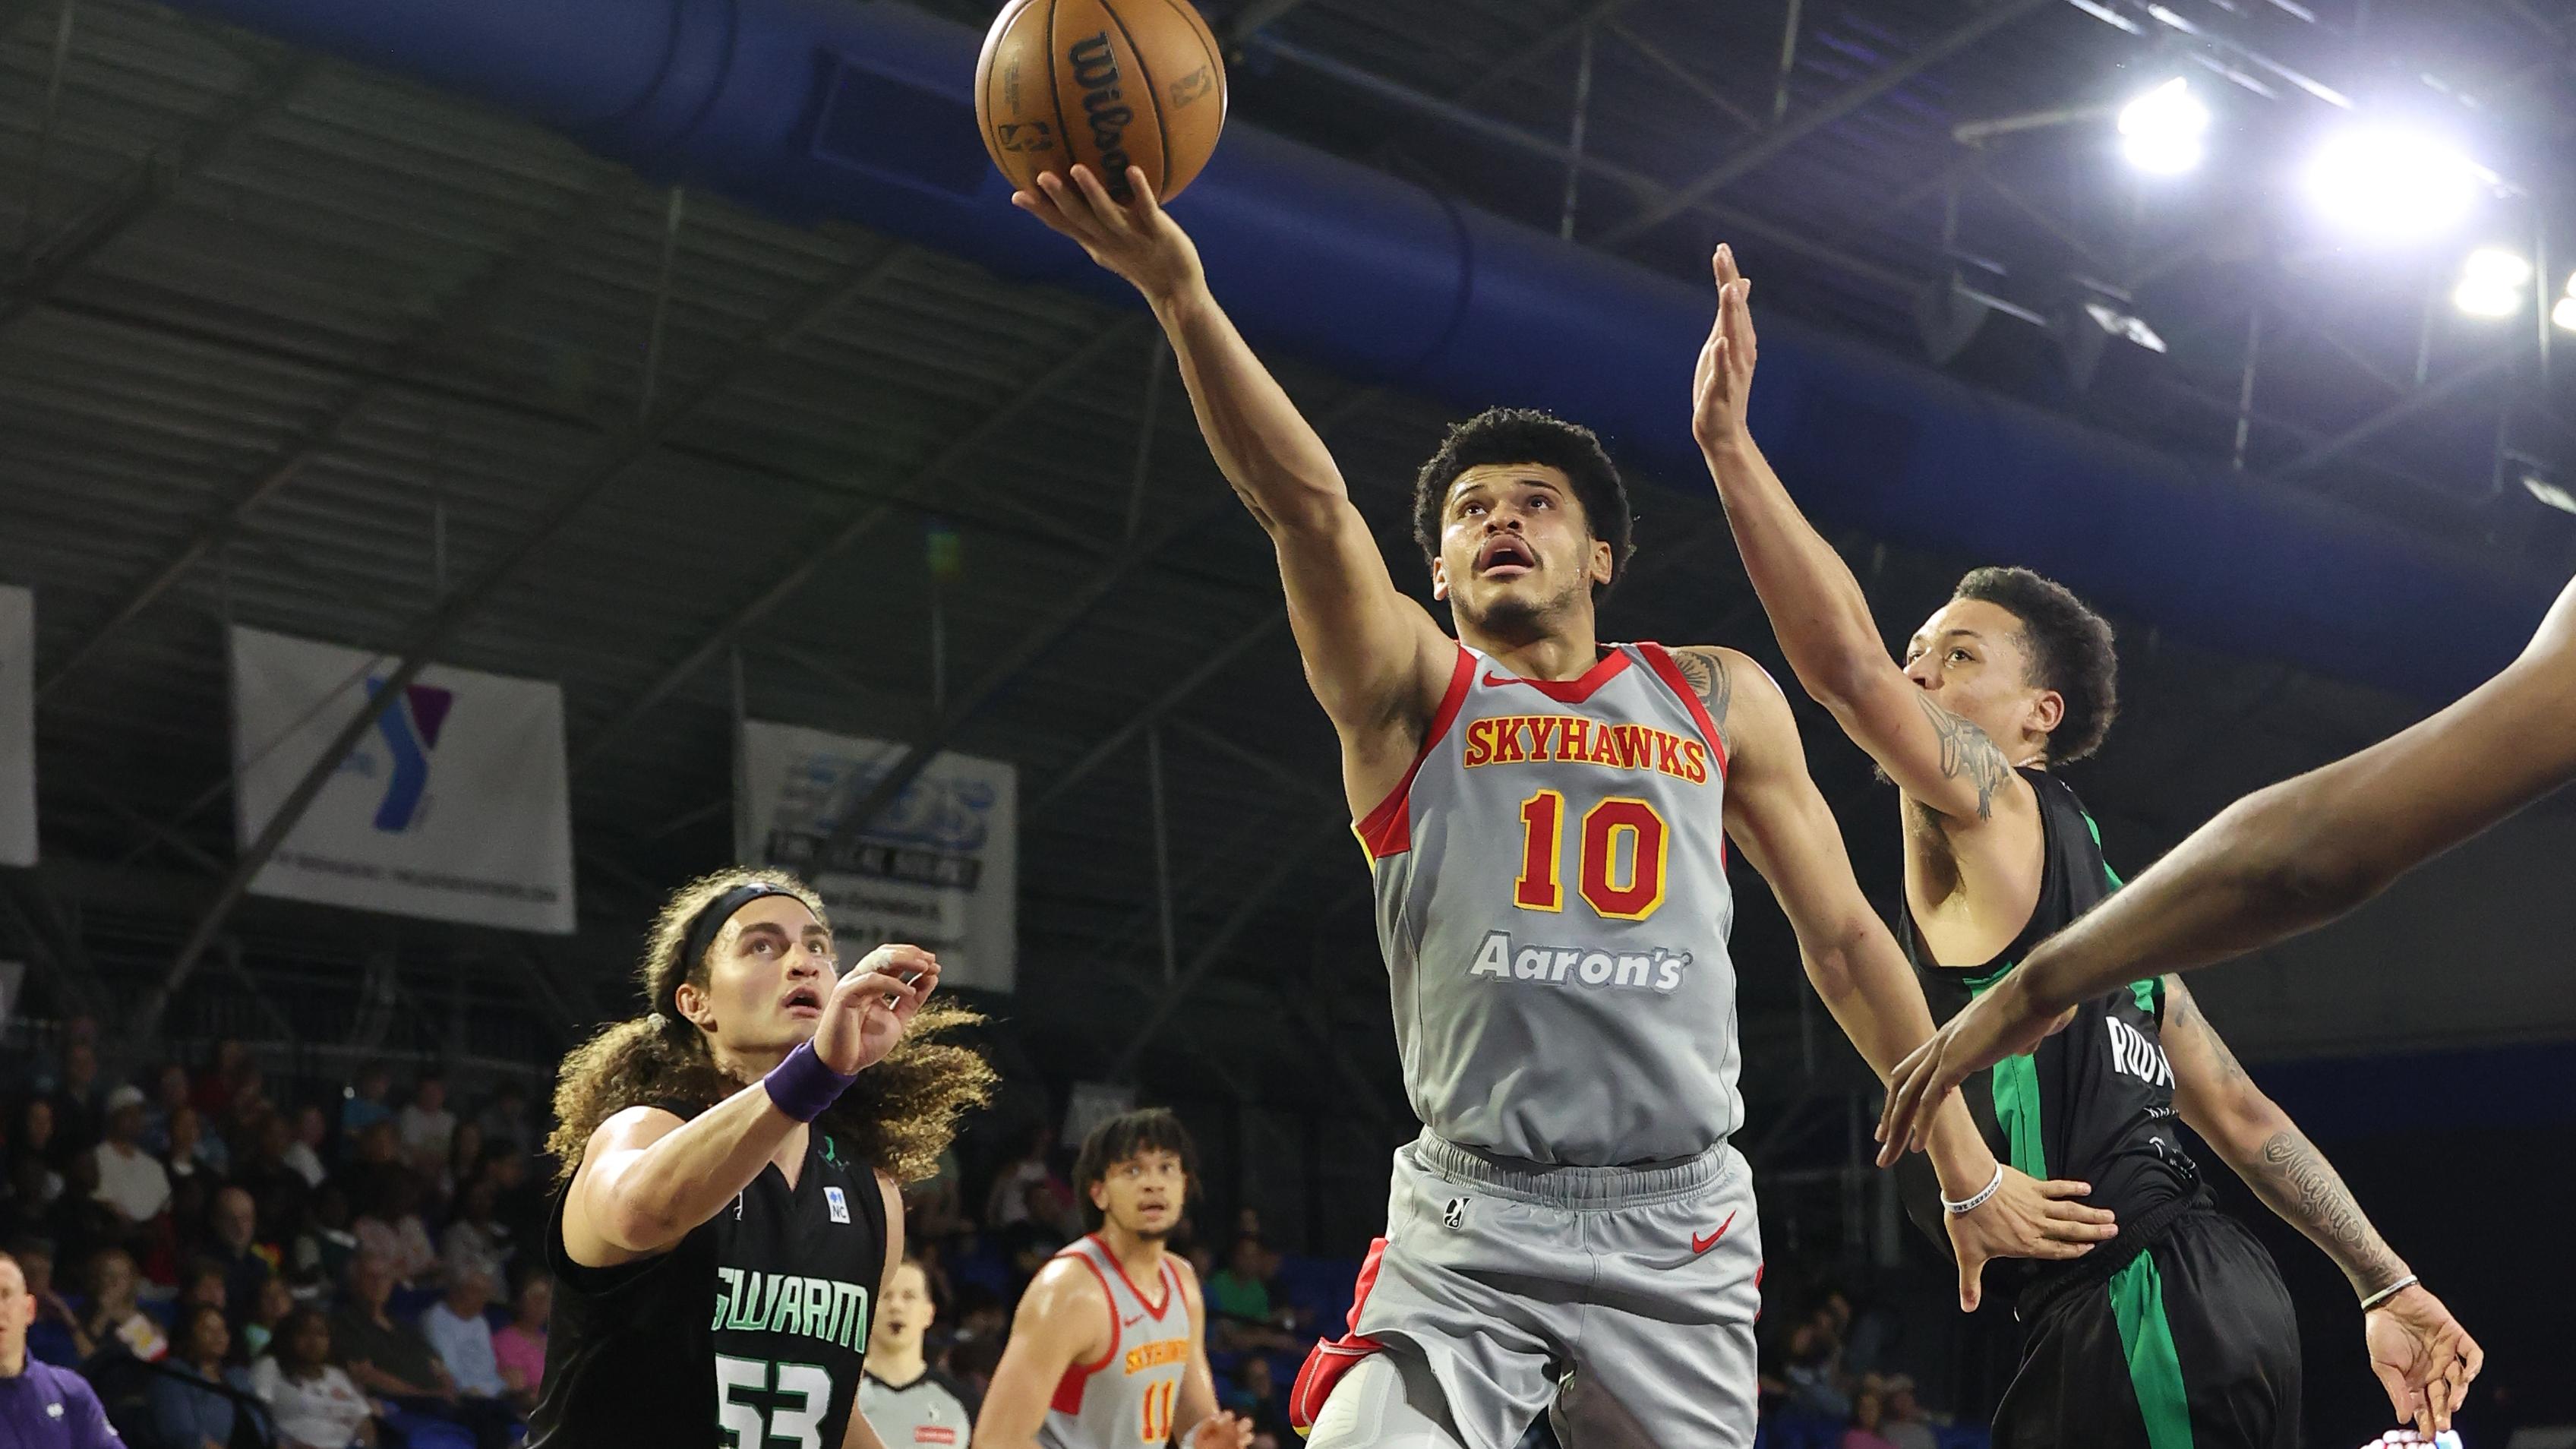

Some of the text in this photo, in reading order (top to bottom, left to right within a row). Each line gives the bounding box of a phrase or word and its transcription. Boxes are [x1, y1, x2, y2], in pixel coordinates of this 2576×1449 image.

[1069, 29, 1135, 204] Wilson
[1464, 715, 1708, 785] SKYHAWKS
[1514, 788, 1669, 921] 10
[1467, 930, 1683, 991] Aaron's
[715, 1352, 832, 1449] 53
[1142, 1376, 1175, 1444] 11
